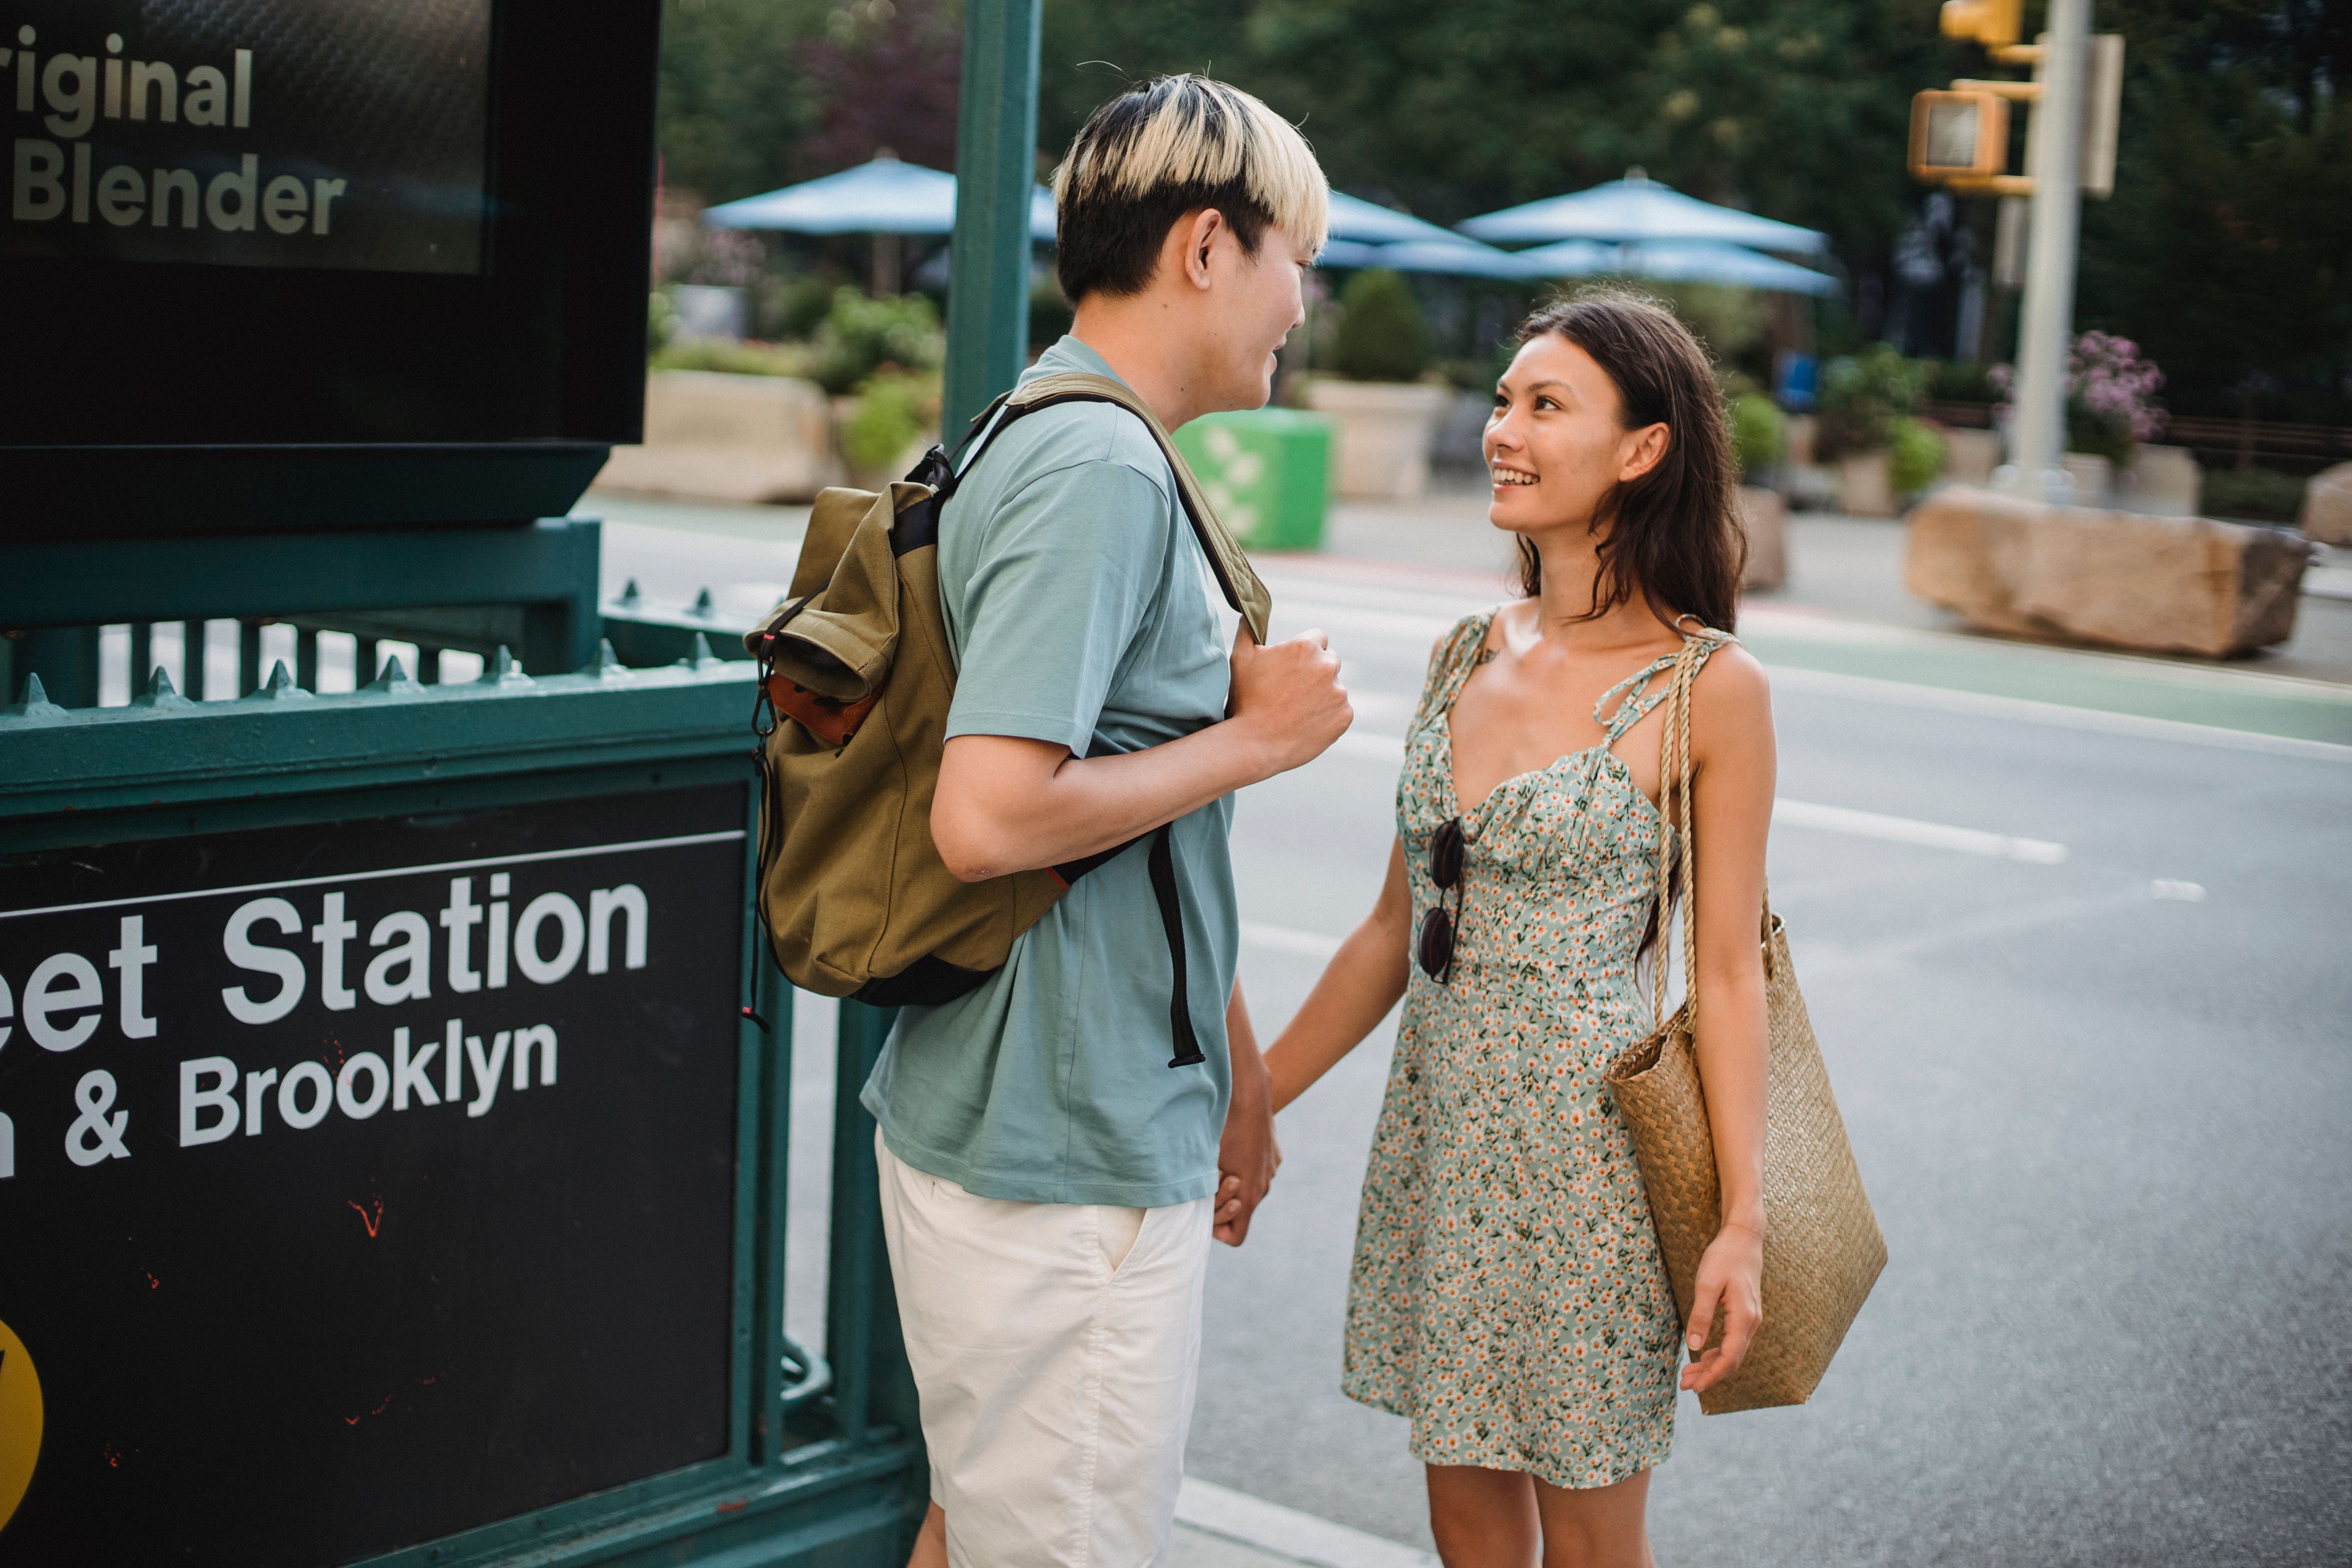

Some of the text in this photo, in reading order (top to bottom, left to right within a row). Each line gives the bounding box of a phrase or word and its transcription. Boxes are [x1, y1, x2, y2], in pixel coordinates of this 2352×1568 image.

[13, 139, 347, 235] Blender
[0, 873, 648, 1052] et Station
[65, 1069, 131, 1167] &
[180, 1018, 557, 1147] Brooklyn
